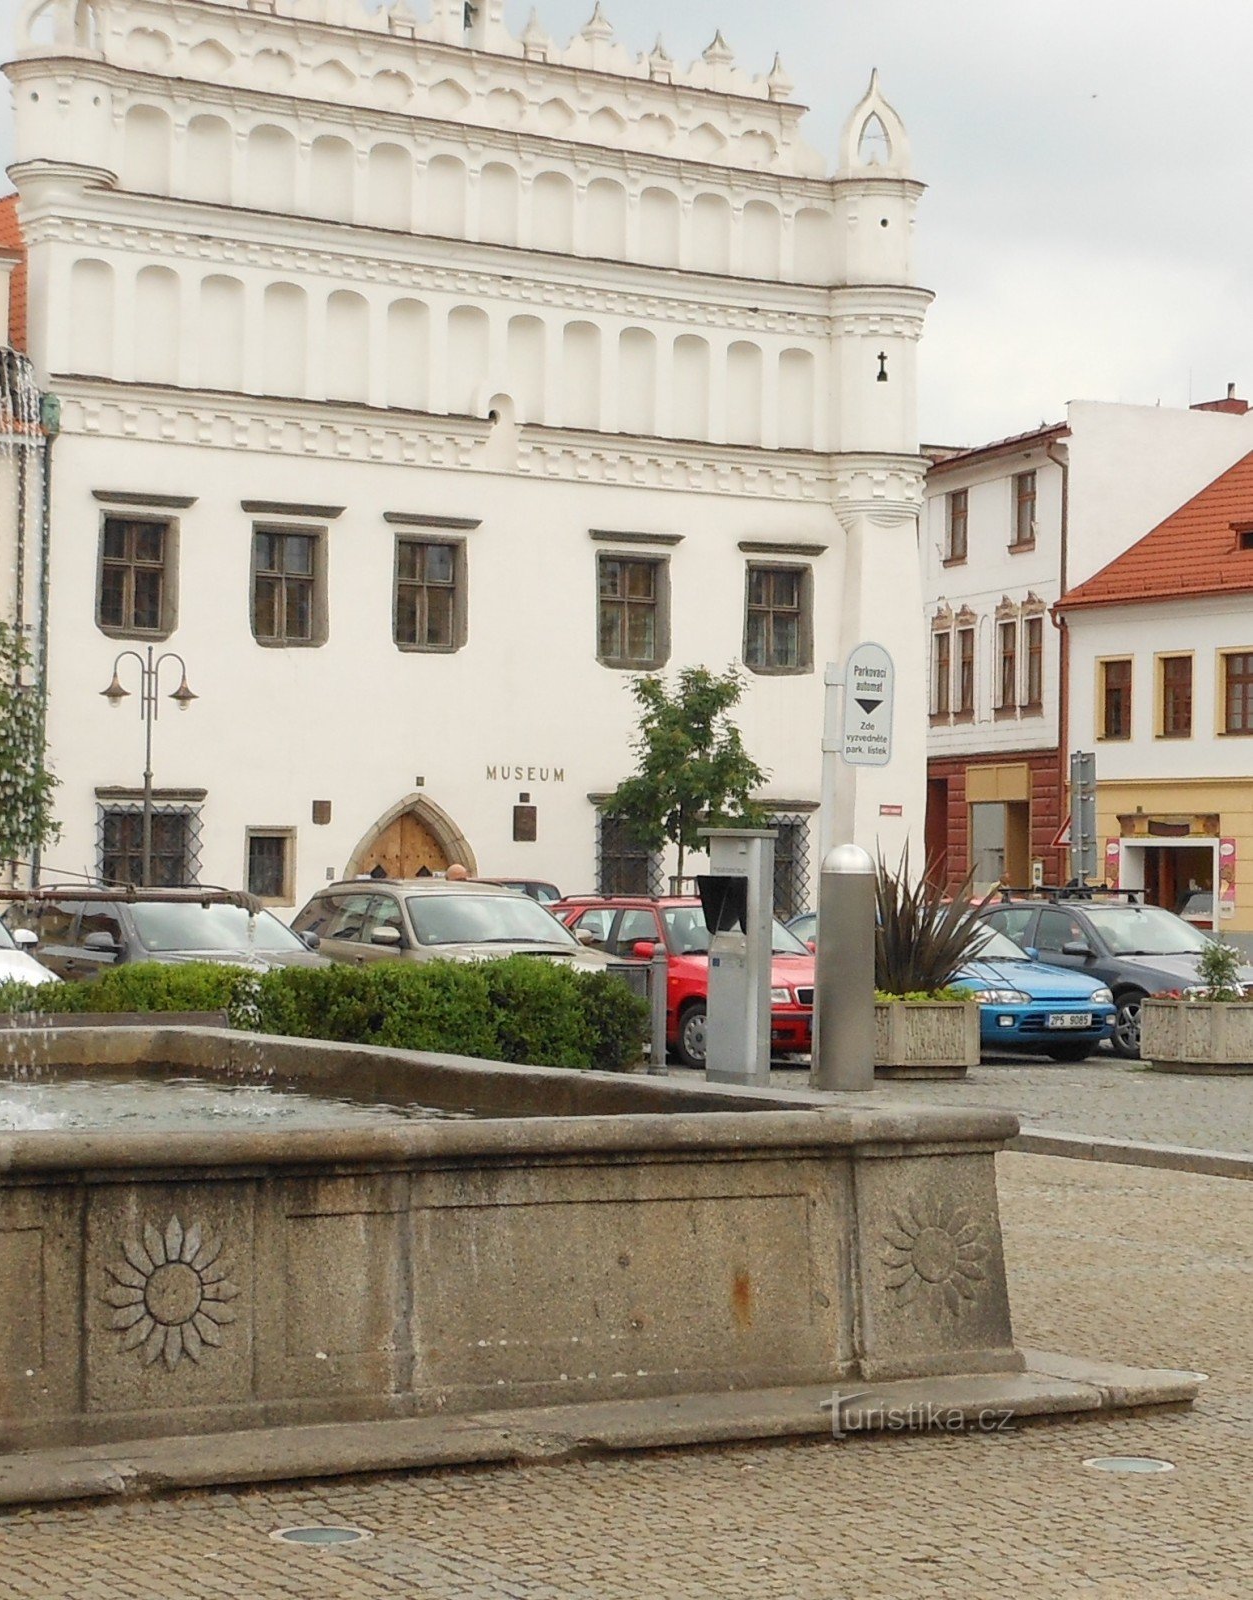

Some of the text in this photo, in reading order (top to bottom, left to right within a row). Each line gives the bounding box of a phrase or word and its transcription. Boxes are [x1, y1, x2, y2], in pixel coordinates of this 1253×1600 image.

[856, 681, 883, 692] automat
[860, 722, 875, 731] Zde
[486, 765, 564, 782] MUSEUM
